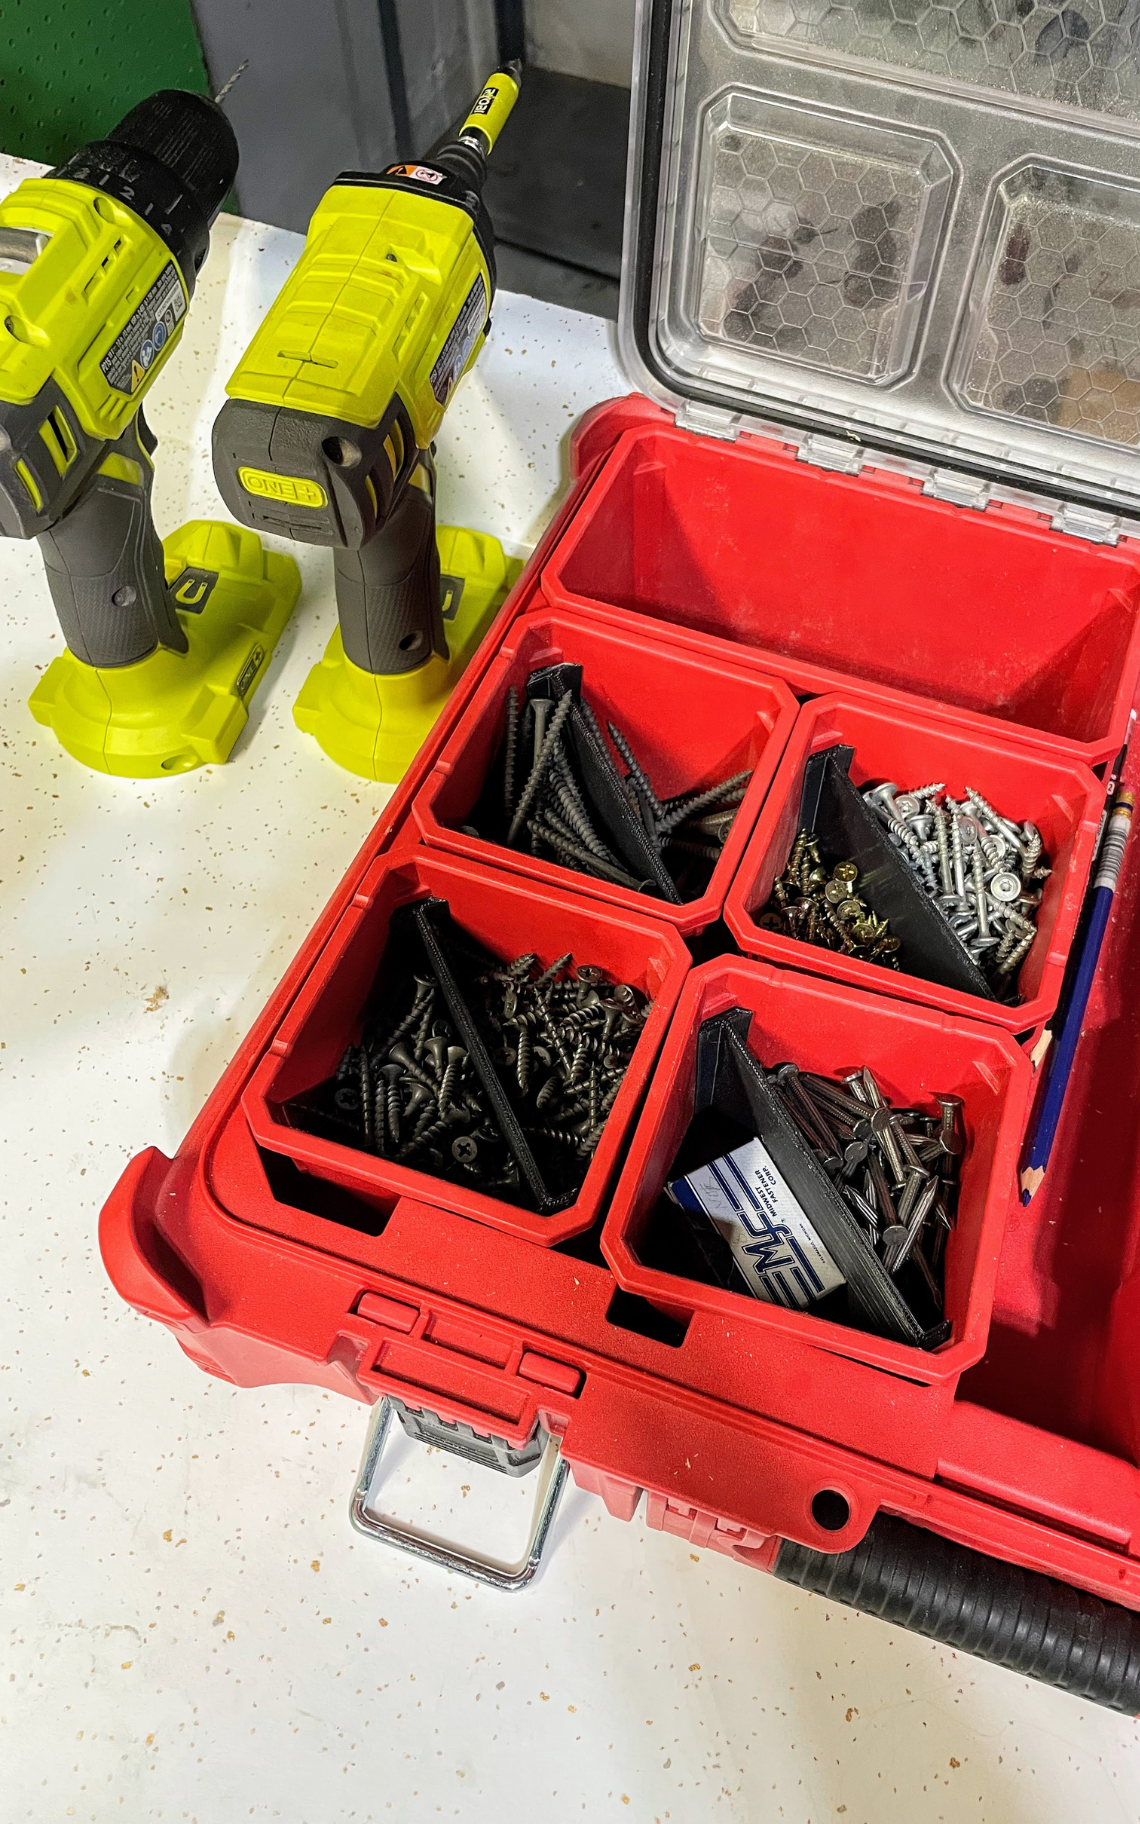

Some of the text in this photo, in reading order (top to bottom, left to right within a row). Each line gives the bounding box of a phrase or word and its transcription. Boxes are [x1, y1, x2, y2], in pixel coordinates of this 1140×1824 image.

[754, 1169, 778, 1203] FASTENER
[762, 1165, 777, 1185] CORP.
[755, 1186, 777, 1217] MIDWEST
